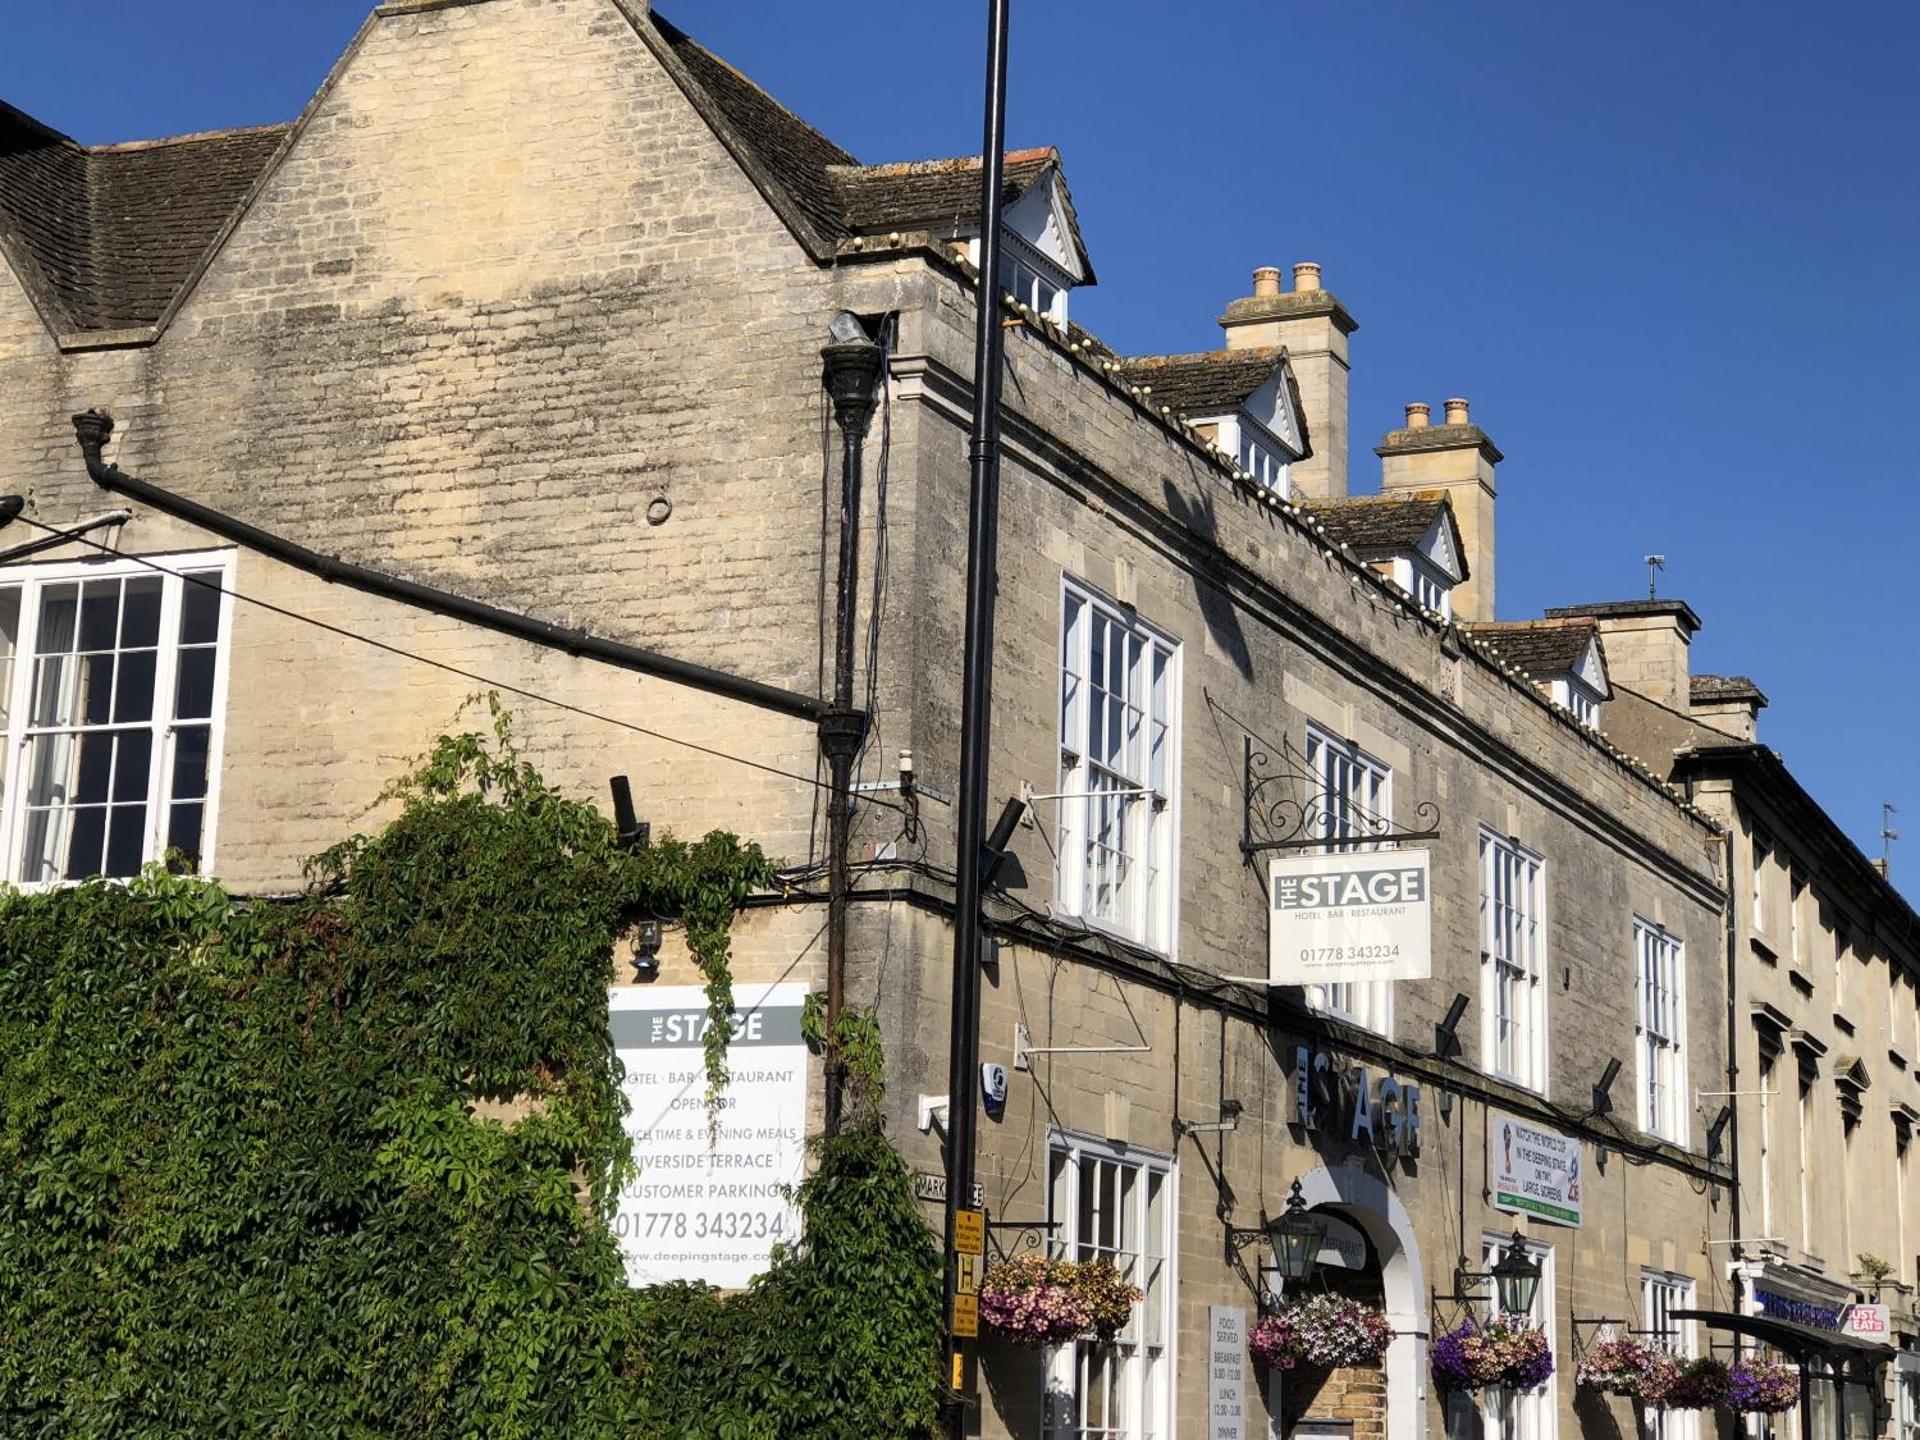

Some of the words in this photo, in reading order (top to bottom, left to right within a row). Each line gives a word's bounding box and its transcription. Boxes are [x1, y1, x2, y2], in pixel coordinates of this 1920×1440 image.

[1281, 879, 1297, 908] THE
[1300, 871, 1419, 907] STAGE
[1294, 912, 1321, 920] HOTEL
[1327, 910, 1344, 919] BAR
[1351, 906, 1406, 917] RESTAURANT
[1300, 948, 1343, 961] 01778
[1348, 944, 1399, 959] 343234
[651, 1016, 663, 1043] THE
[668, 1072, 695, 1083] BAR
[729, 1071, 794, 1083] TAURANT
[655, 1129, 682, 1140] TIME
[697, 1128, 753, 1140] EVNING
[756, 1127, 797, 1139] MEALS
[631, 1154, 703, 1168] RIVERSIDE
[710, 1154, 773, 1168] TERRACE
[622, 1184, 704, 1198] CUSTOMER
[708, 1184, 778, 1198] PARKING
[915, 1177, 947, 1198] MARK
[616, 1212, 687, 1238] 01778
[694, 1212, 783, 1238] 343234
[1219, 1318, 1235, 1330] FOOD
[1853, 1320, 1875, 1331] EAT
[1216, 1331, 1239, 1344] SERVED
